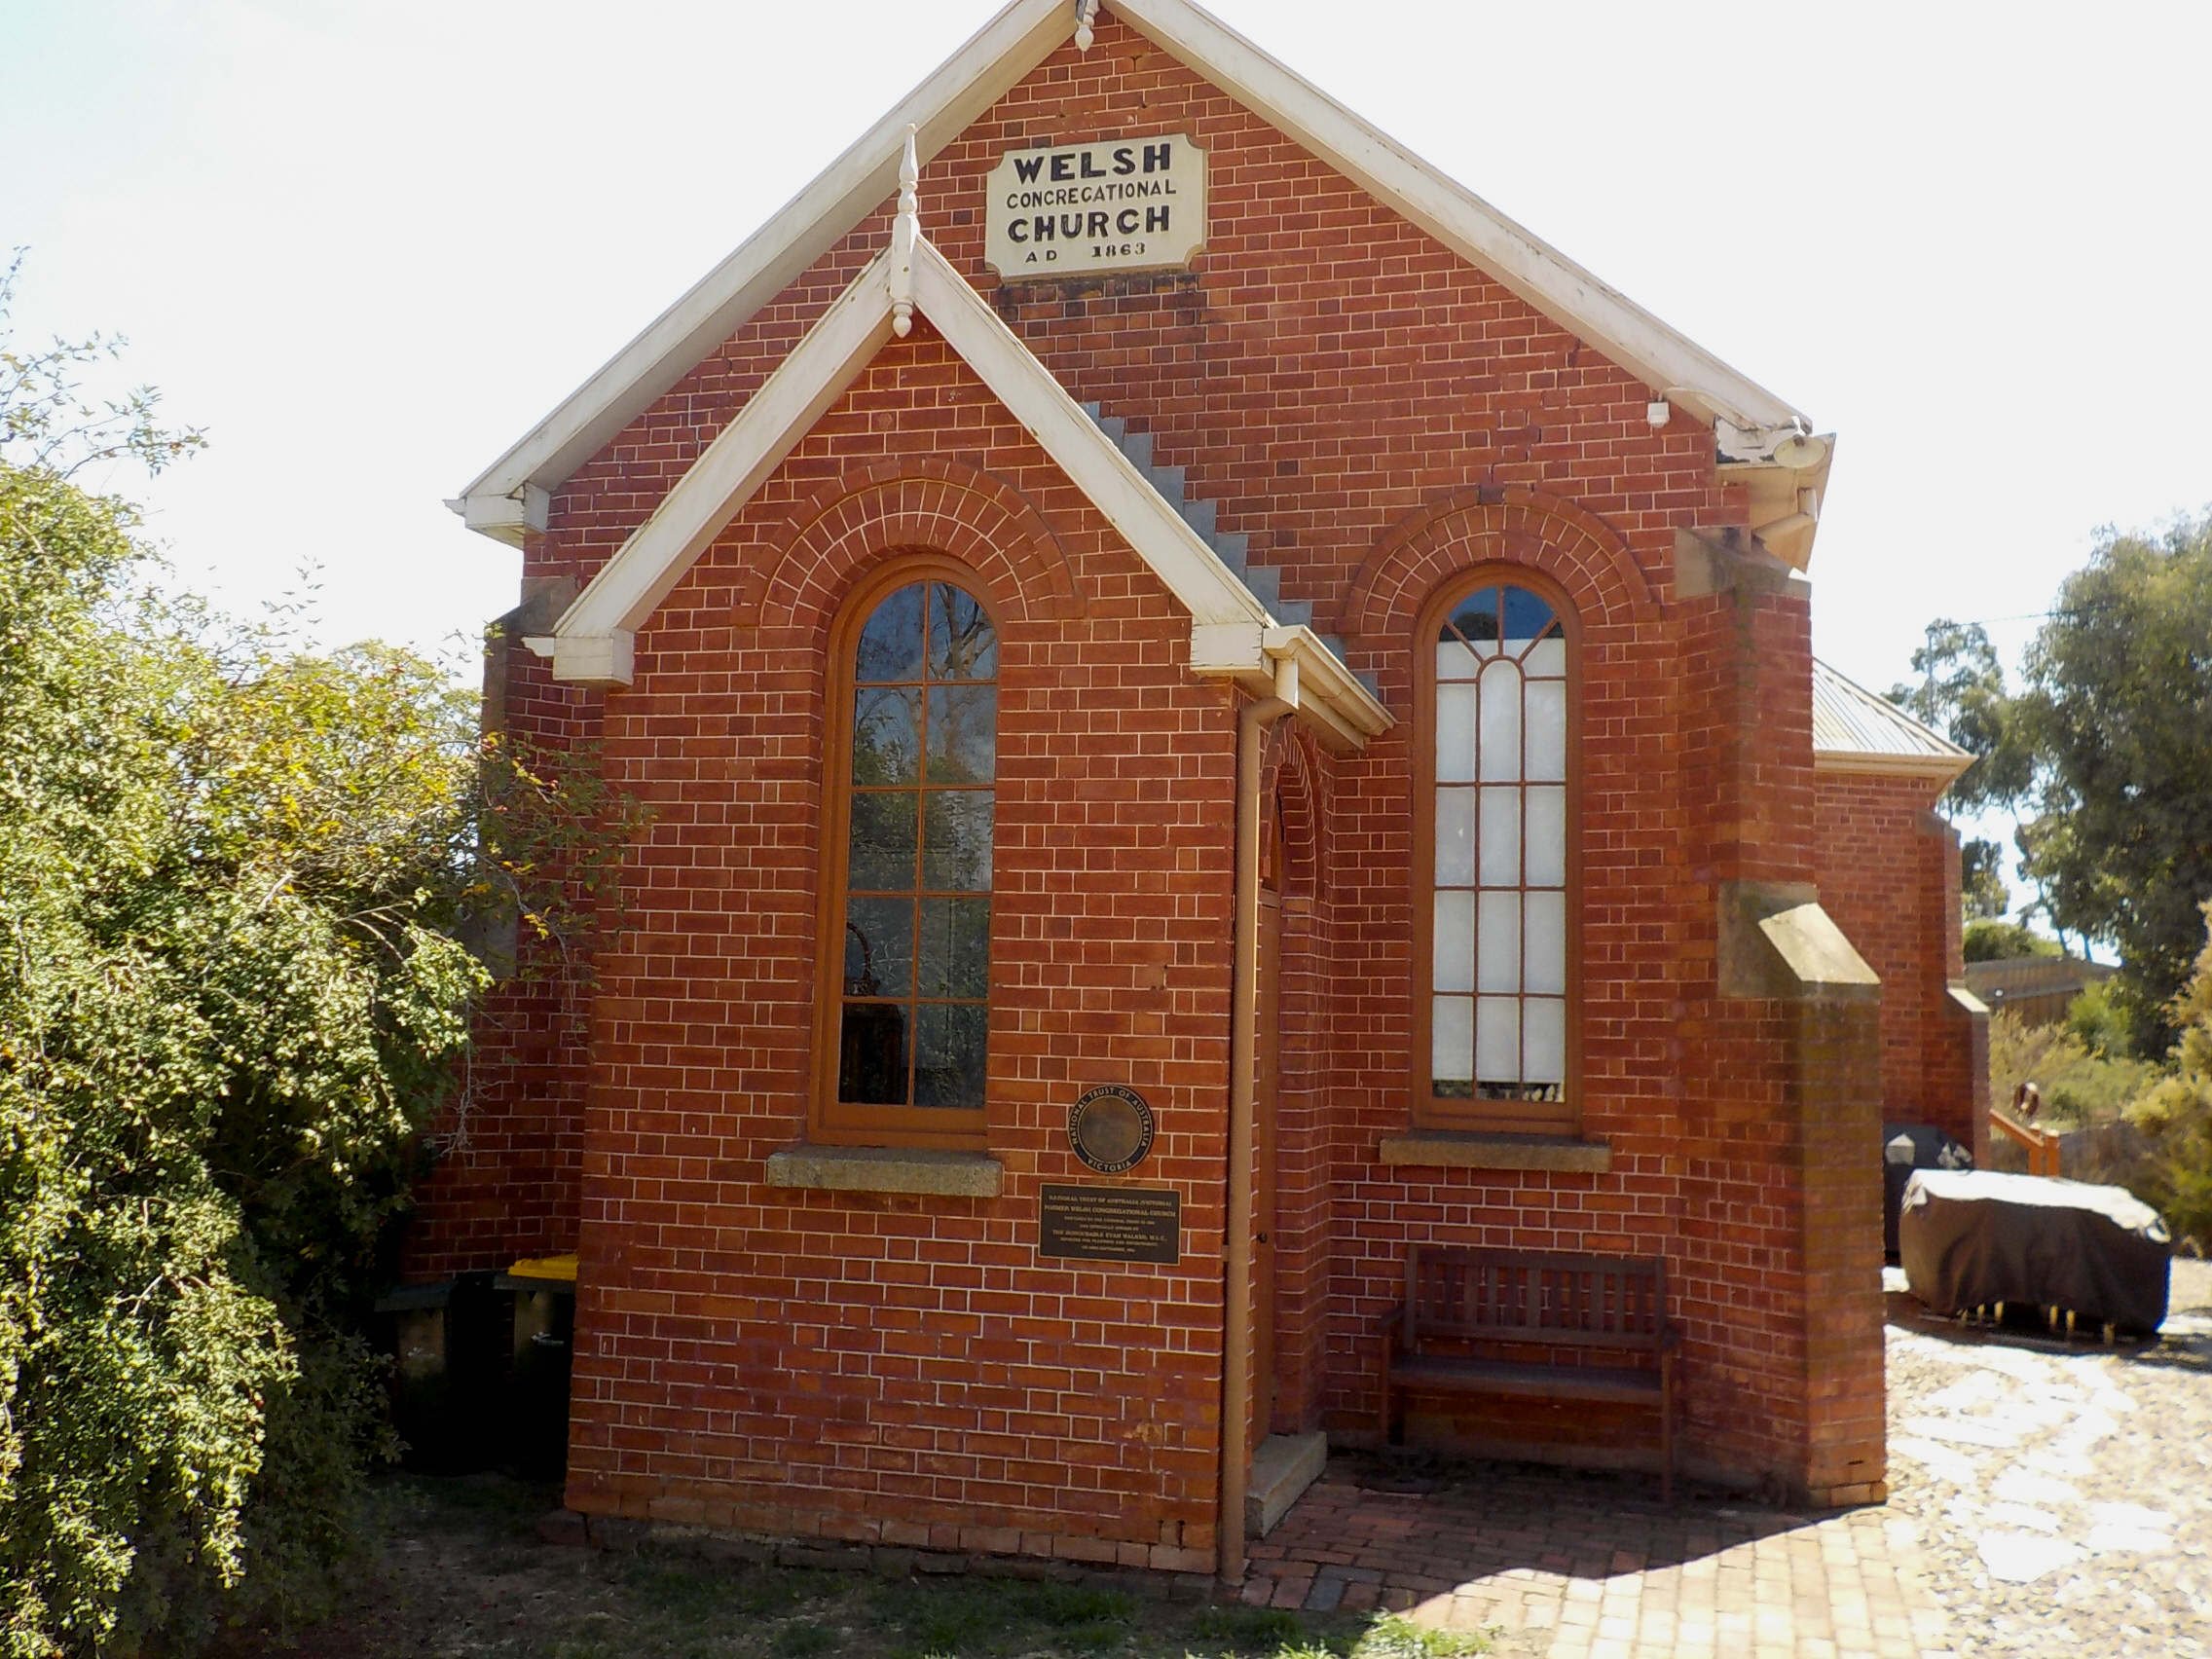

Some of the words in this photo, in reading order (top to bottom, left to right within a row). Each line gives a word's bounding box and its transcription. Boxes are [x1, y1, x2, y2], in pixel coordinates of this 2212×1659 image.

[1014, 143, 1171, 184] WELSH
[1008, 205, 1170, 243] CHURCH
[1091, 242, 1147, 258] 1863
[1070, 1099, 1088, 1144] NATIONAL
[1089, 1088, 1115, 1099] TRUST
[1118, 1089, 1131, 1100] OF
[1132, 1099, 1151, 1147] AUSTRALIA
[1088, 1159, 1133, 1172] VICTORIA
